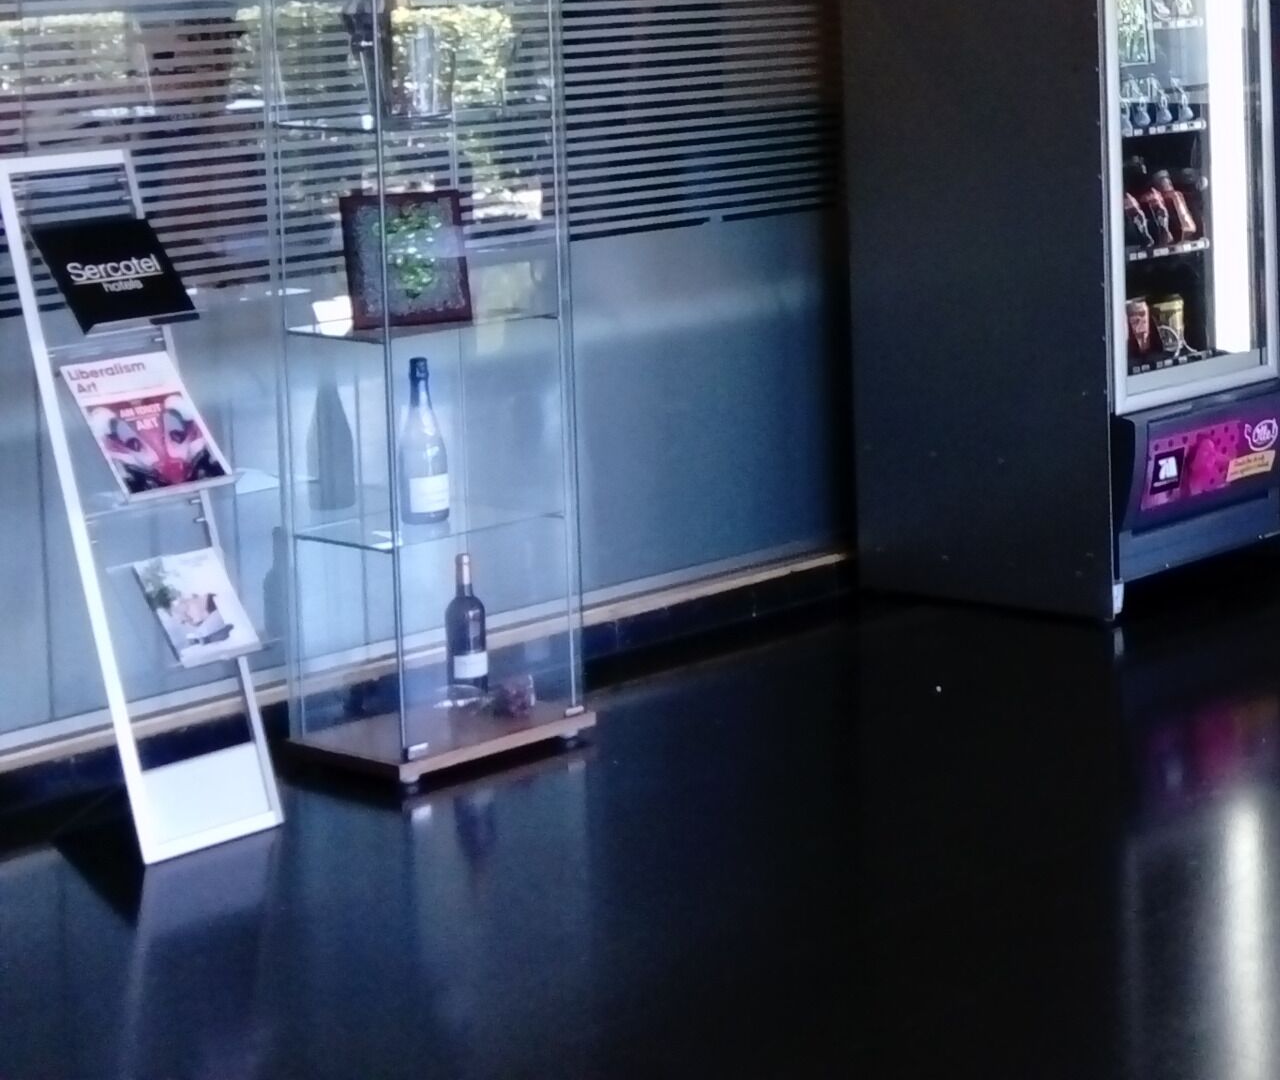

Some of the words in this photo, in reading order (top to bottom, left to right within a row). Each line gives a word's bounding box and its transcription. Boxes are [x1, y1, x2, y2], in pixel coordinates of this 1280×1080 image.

[66, 253, 161, 281] Sercotel
[102, 279, 144, 293] hotels
[67, 362, 146, 381] Liberalism
[77, 381, 98, 393] Art
